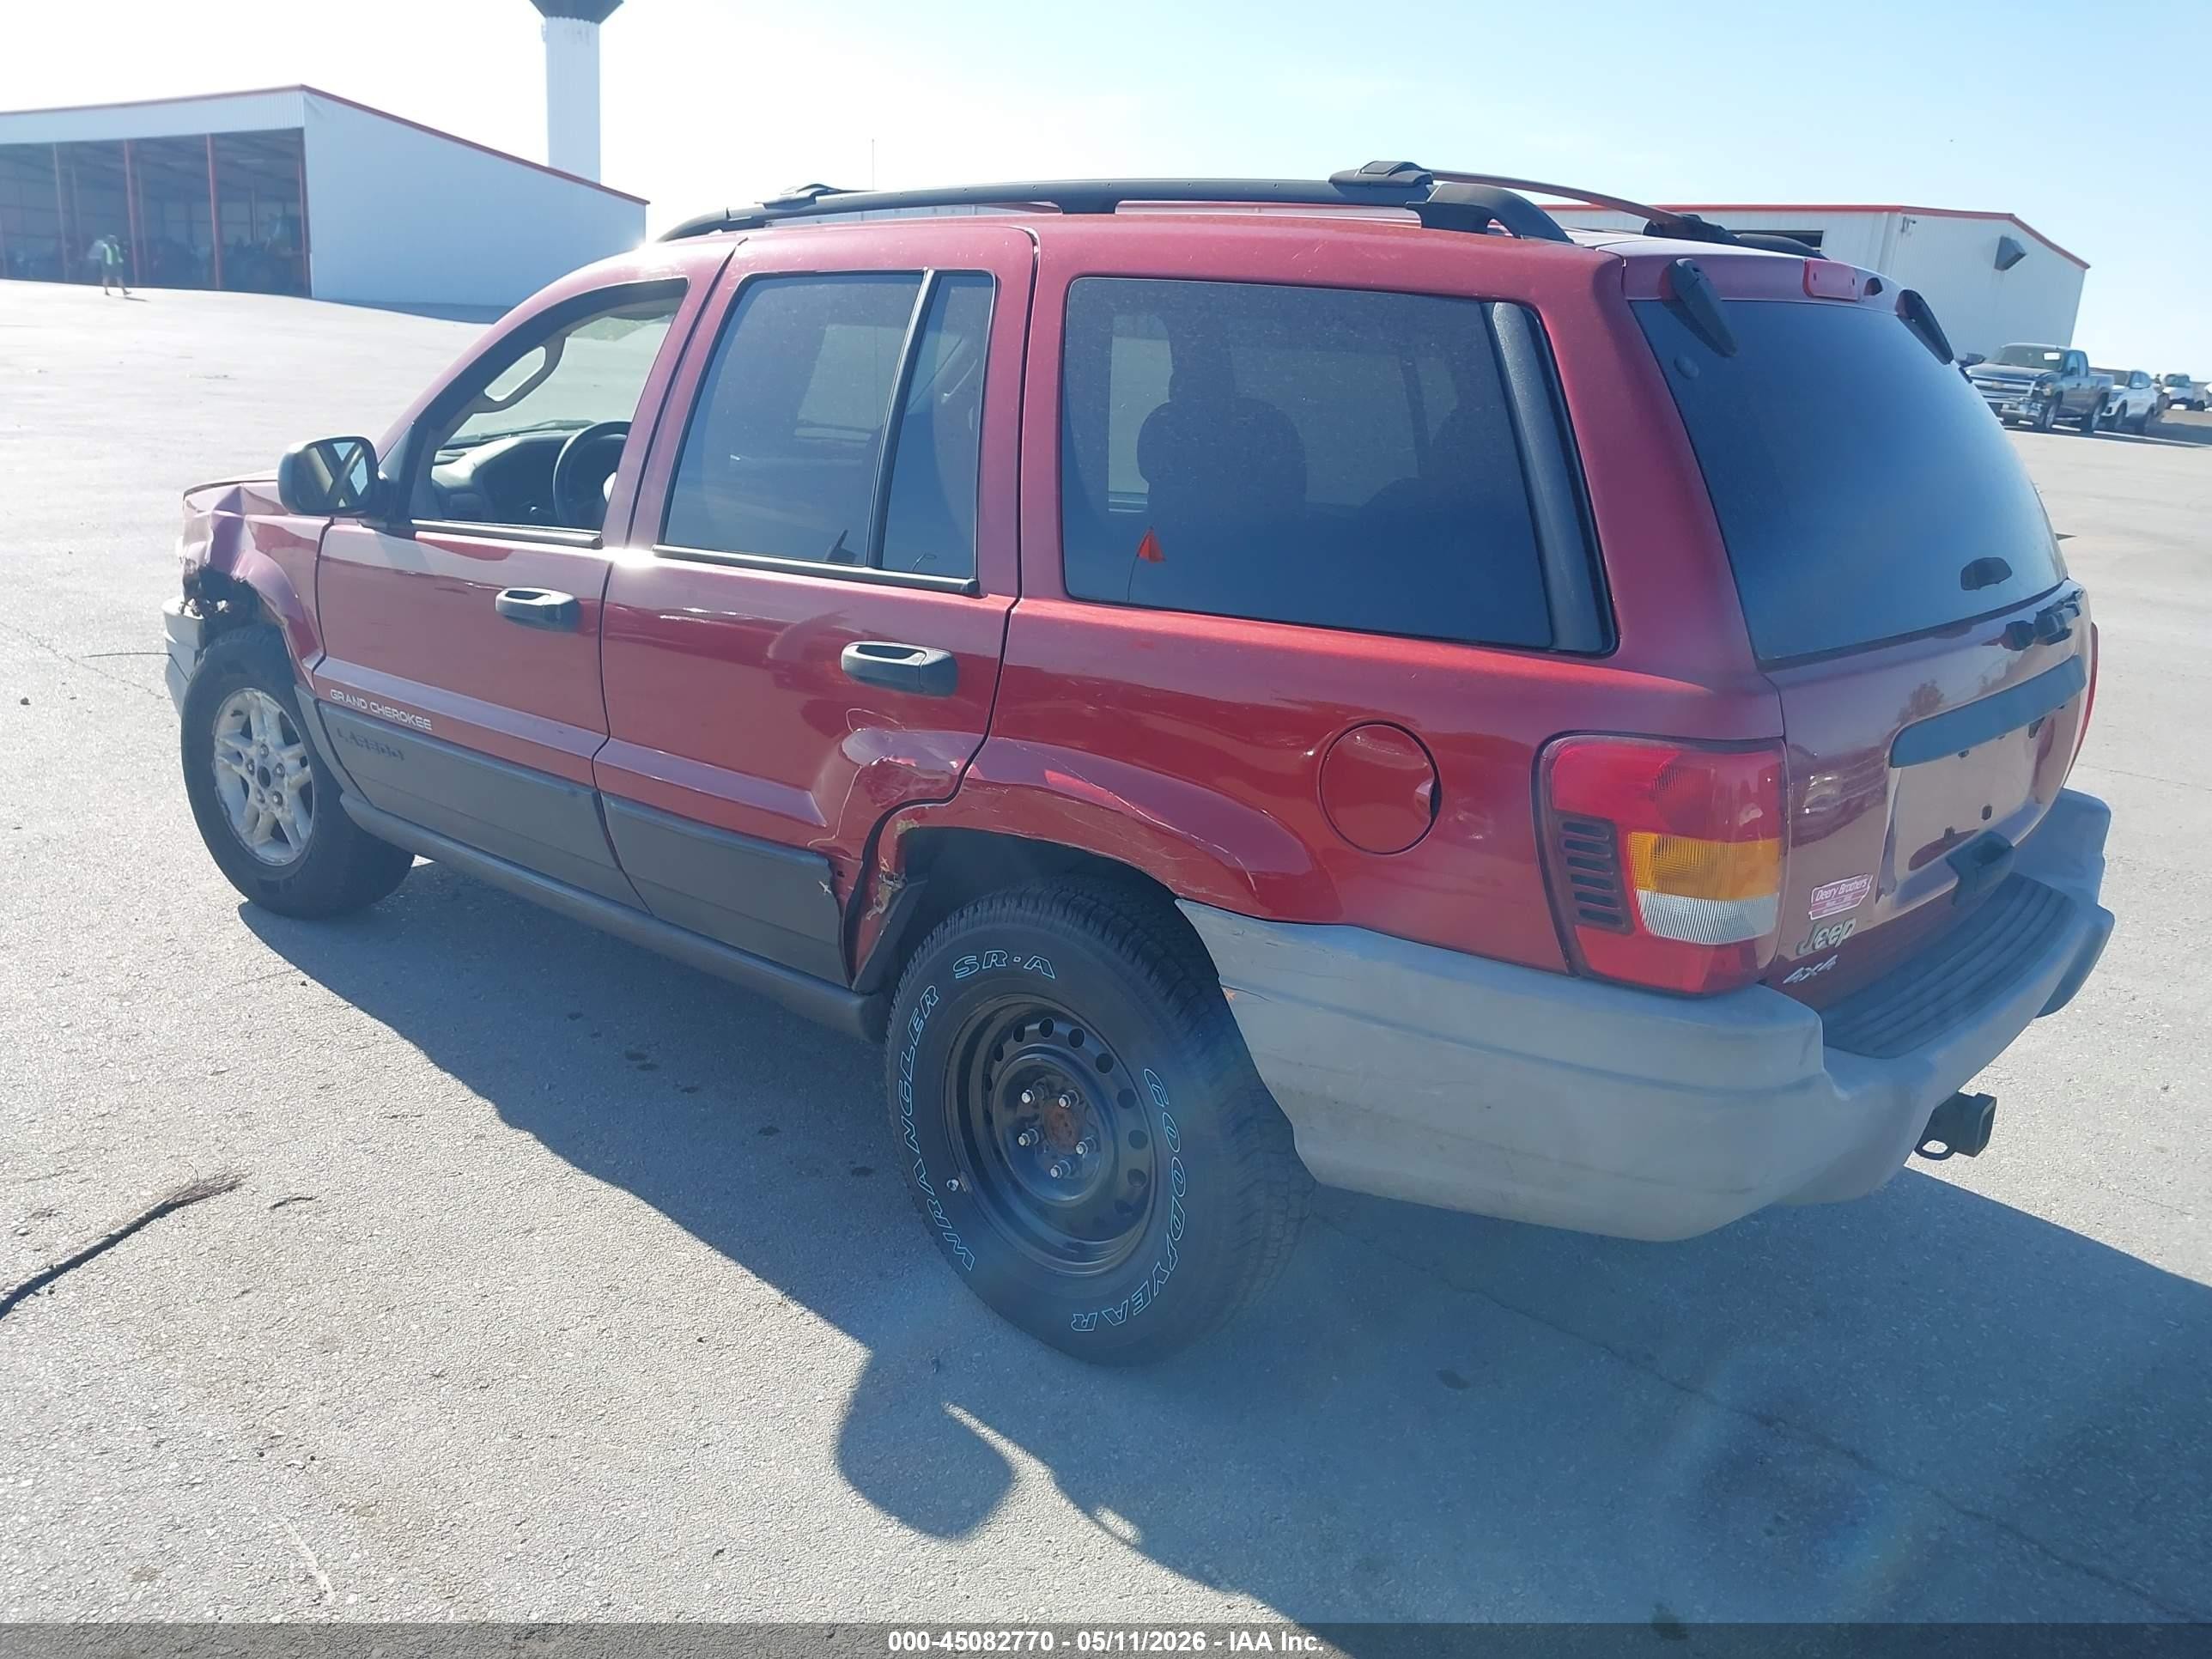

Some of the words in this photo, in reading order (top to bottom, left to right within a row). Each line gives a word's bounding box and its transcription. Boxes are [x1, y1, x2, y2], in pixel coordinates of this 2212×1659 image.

[330, 689, 368, 709] GRAND
[369, 702, 433, 730] CHEROKEE
[1796, 918, 1856, 955] Jeep
[897, 984, 975, 1272] WRANGLER
[1070, 1067, 1187, 1333] GOODYEAR
